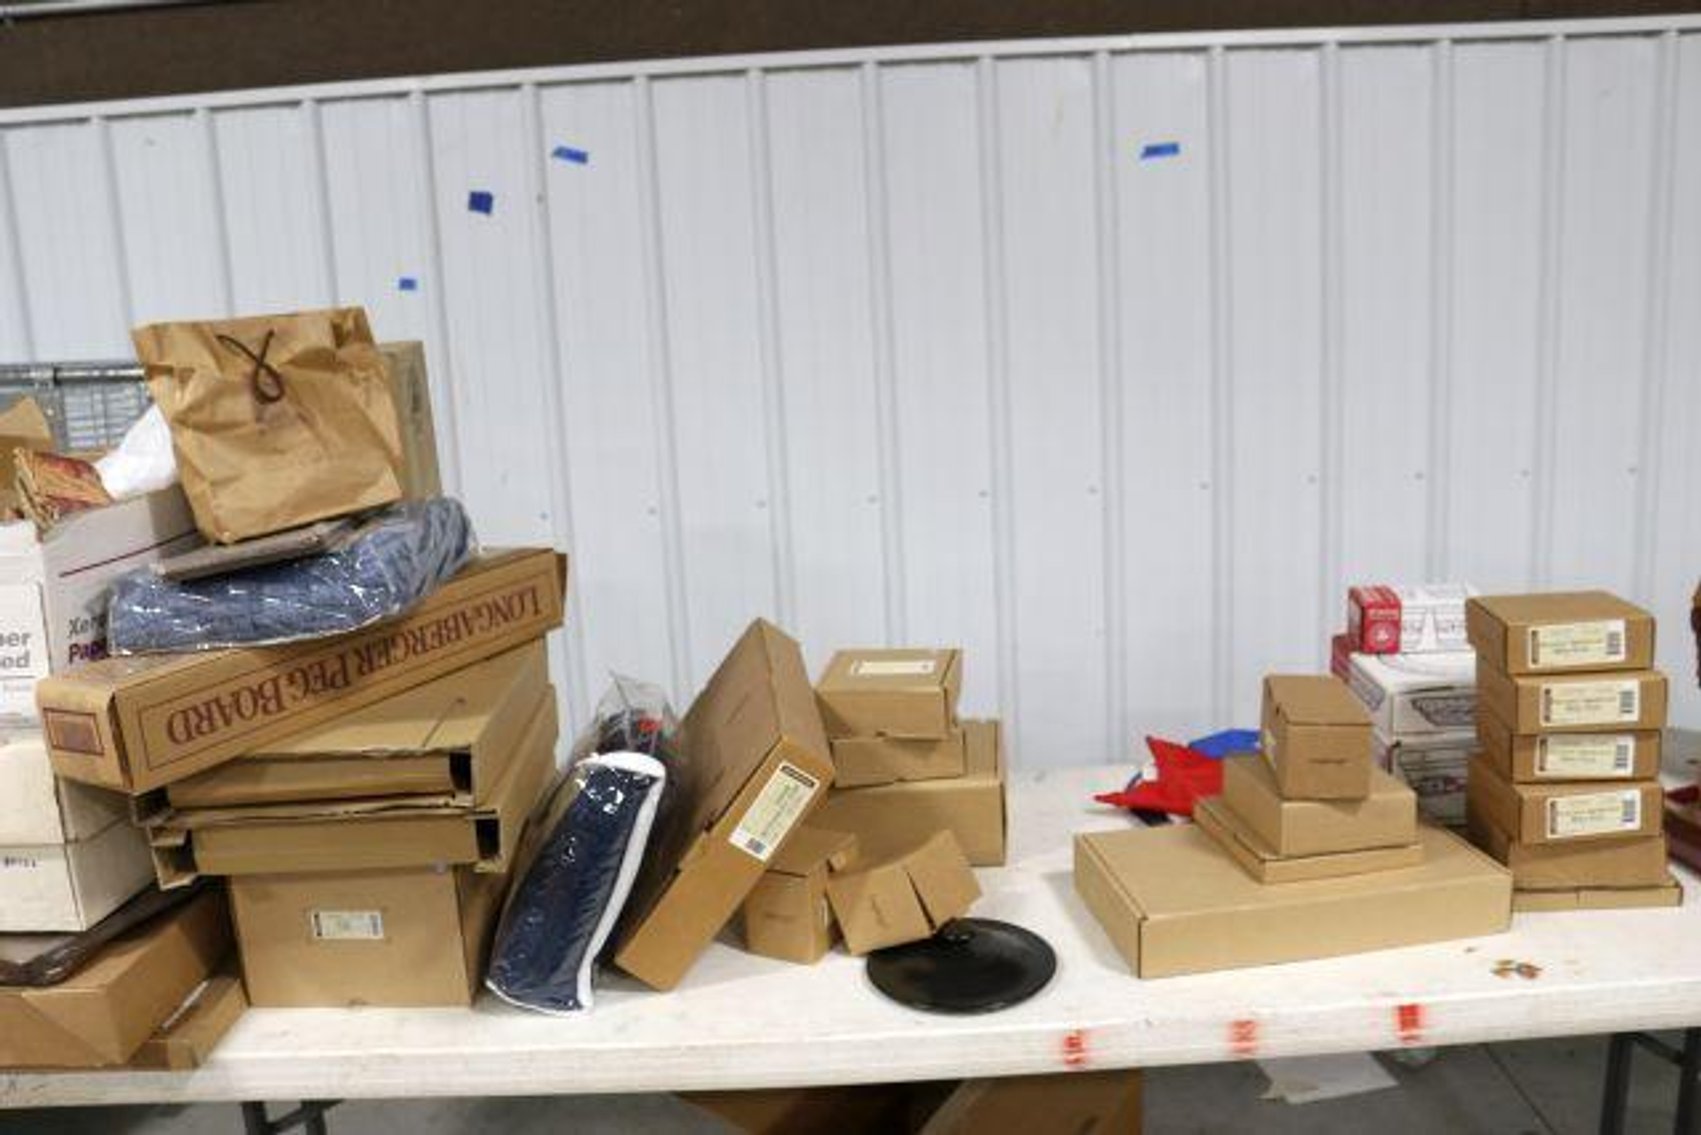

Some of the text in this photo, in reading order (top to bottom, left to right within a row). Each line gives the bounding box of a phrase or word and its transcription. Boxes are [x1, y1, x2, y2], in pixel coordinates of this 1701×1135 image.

[356, 586, 542, 677] LONGABERGER
[166, 675, 285, 746] BOARD
[286, 654, 350, 701] PEG
